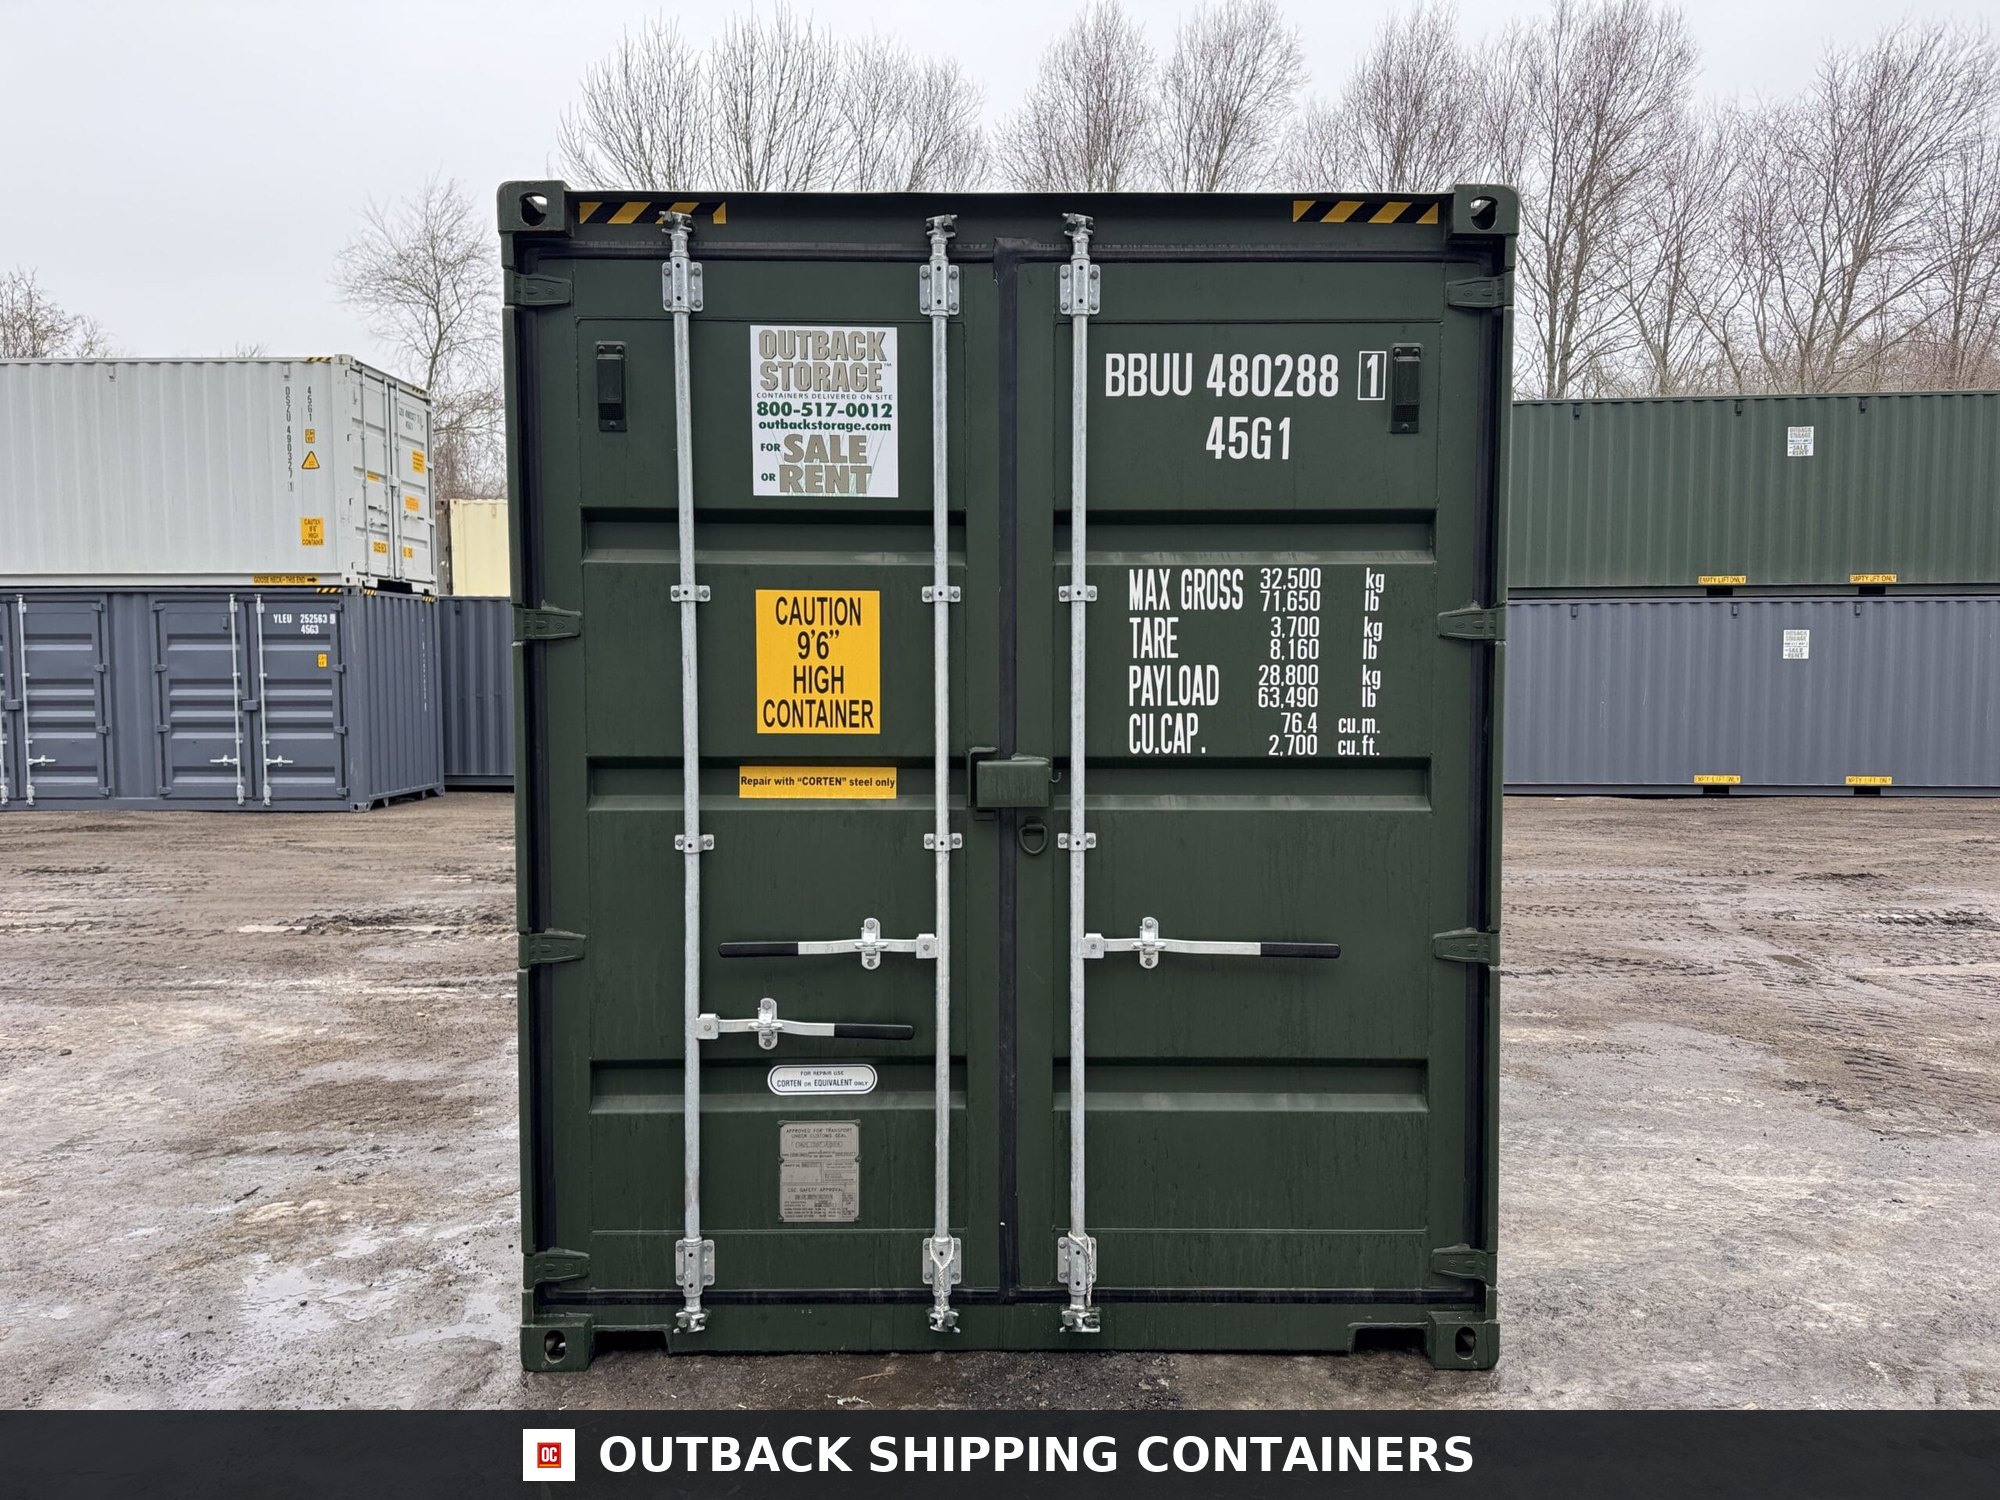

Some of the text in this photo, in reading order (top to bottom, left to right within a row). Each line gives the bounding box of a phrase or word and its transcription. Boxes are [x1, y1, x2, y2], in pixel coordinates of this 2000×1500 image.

[759, 330, 887, 361] OUTBACK
[760, 361, 883, 393] STORAGE
[1105, 352, 1193, 397] BBUU
[1206, 353, 1339, 397] 480288
[757, 402, 893, 418] 800-517-0012
[759, 419, 892, 432] outbackstorage.com
[1206, 416, 1291, 460] 45G1
[761, 434, 867, 464] FOR SALE
[761, 465, 872, 494] OR RENT
[1129, 568, 1244, 611] MAX GROSS
[1260, 567, 1385, 593] 32,500 kg
[775, 596, 862, 626] CAUTION
[1260, 590, 1379, 613] 71,650 lb
[273, 614, 292, 623] YLEU
[300, 614, 328, 624] 252563
[1270, 616, 1383, 642] 3,700 kg
[1129, 617, 1179, 659] TARE
[1270, 638, 1377, 661] 8,160 lb
[793, 665, 844, 694] HIGH
[1129, 664, 1220, 707] PAYLOAD
[1258, 664, 1381, 690] 28,800 kg
[1258, 687, 1376, 709] 63,490 lb
[763, 699, 874, 729] CONTAINER
[1280, 712, 1381, 734] 76.4 cu.m.
[1268, 735, 1380, 757] 2,700 cu.ft.
[740, 776, 895, 789] Repair with “CORTEN” steel only
[814, 1079, 852, 1087] EQUIVALENT
